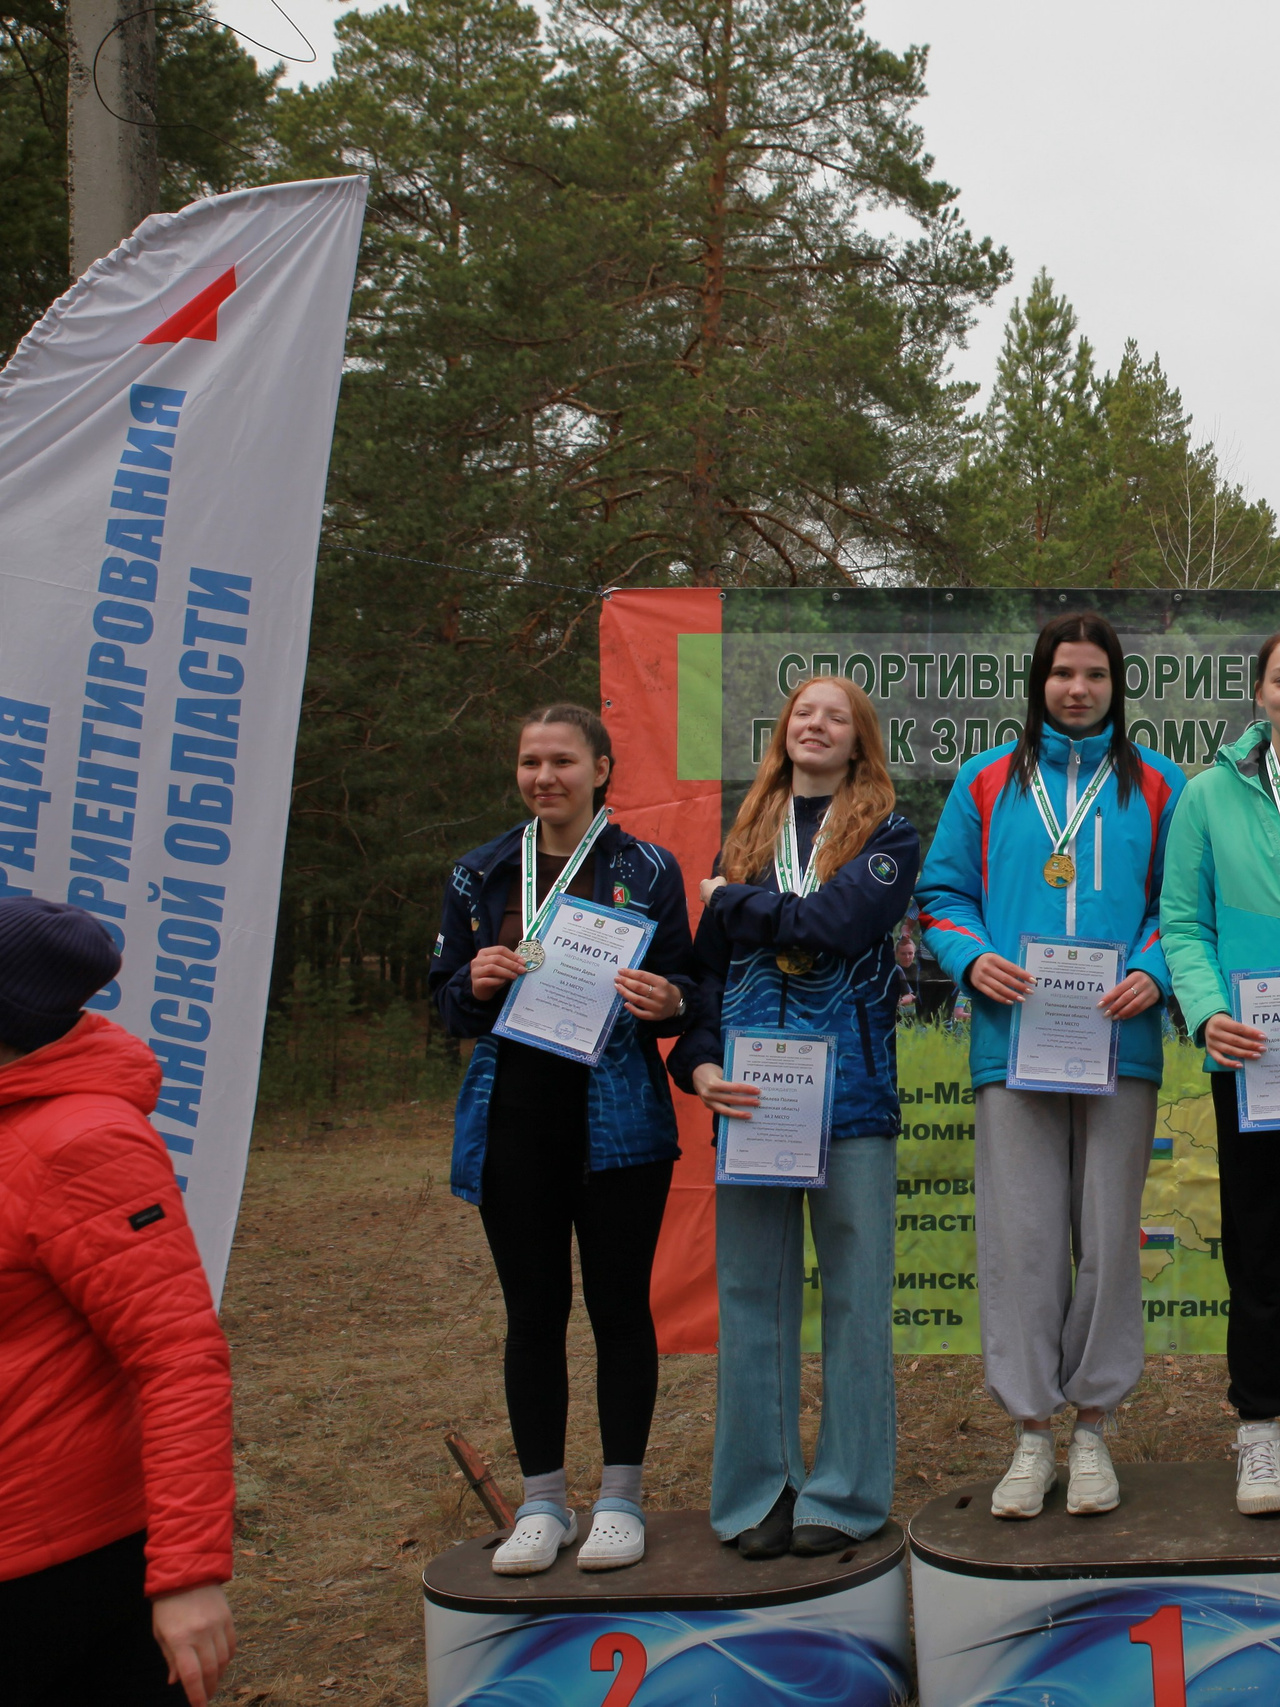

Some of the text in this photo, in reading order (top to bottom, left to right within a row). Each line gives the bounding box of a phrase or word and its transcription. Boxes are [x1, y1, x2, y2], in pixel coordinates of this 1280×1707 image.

[777, 652, 1033, 699] СПОРТИВН
[163, 566, 253, 866] ОБЛАСТИ
[889, 717, 916, 764] К
[930, 717, 1227, 765] ЗДООМУ
[553, 935, 619, 964] ГРАМОТА
[1035, 977, 1105, 992] ГРАМОТА
[743, 1071, 814, 1084] ГРАМОТА
[893, 1308, 963, 1326] асть
[590, 1632, 647, 1707] 2
[1129, 1604, 1187, 1707] 1
